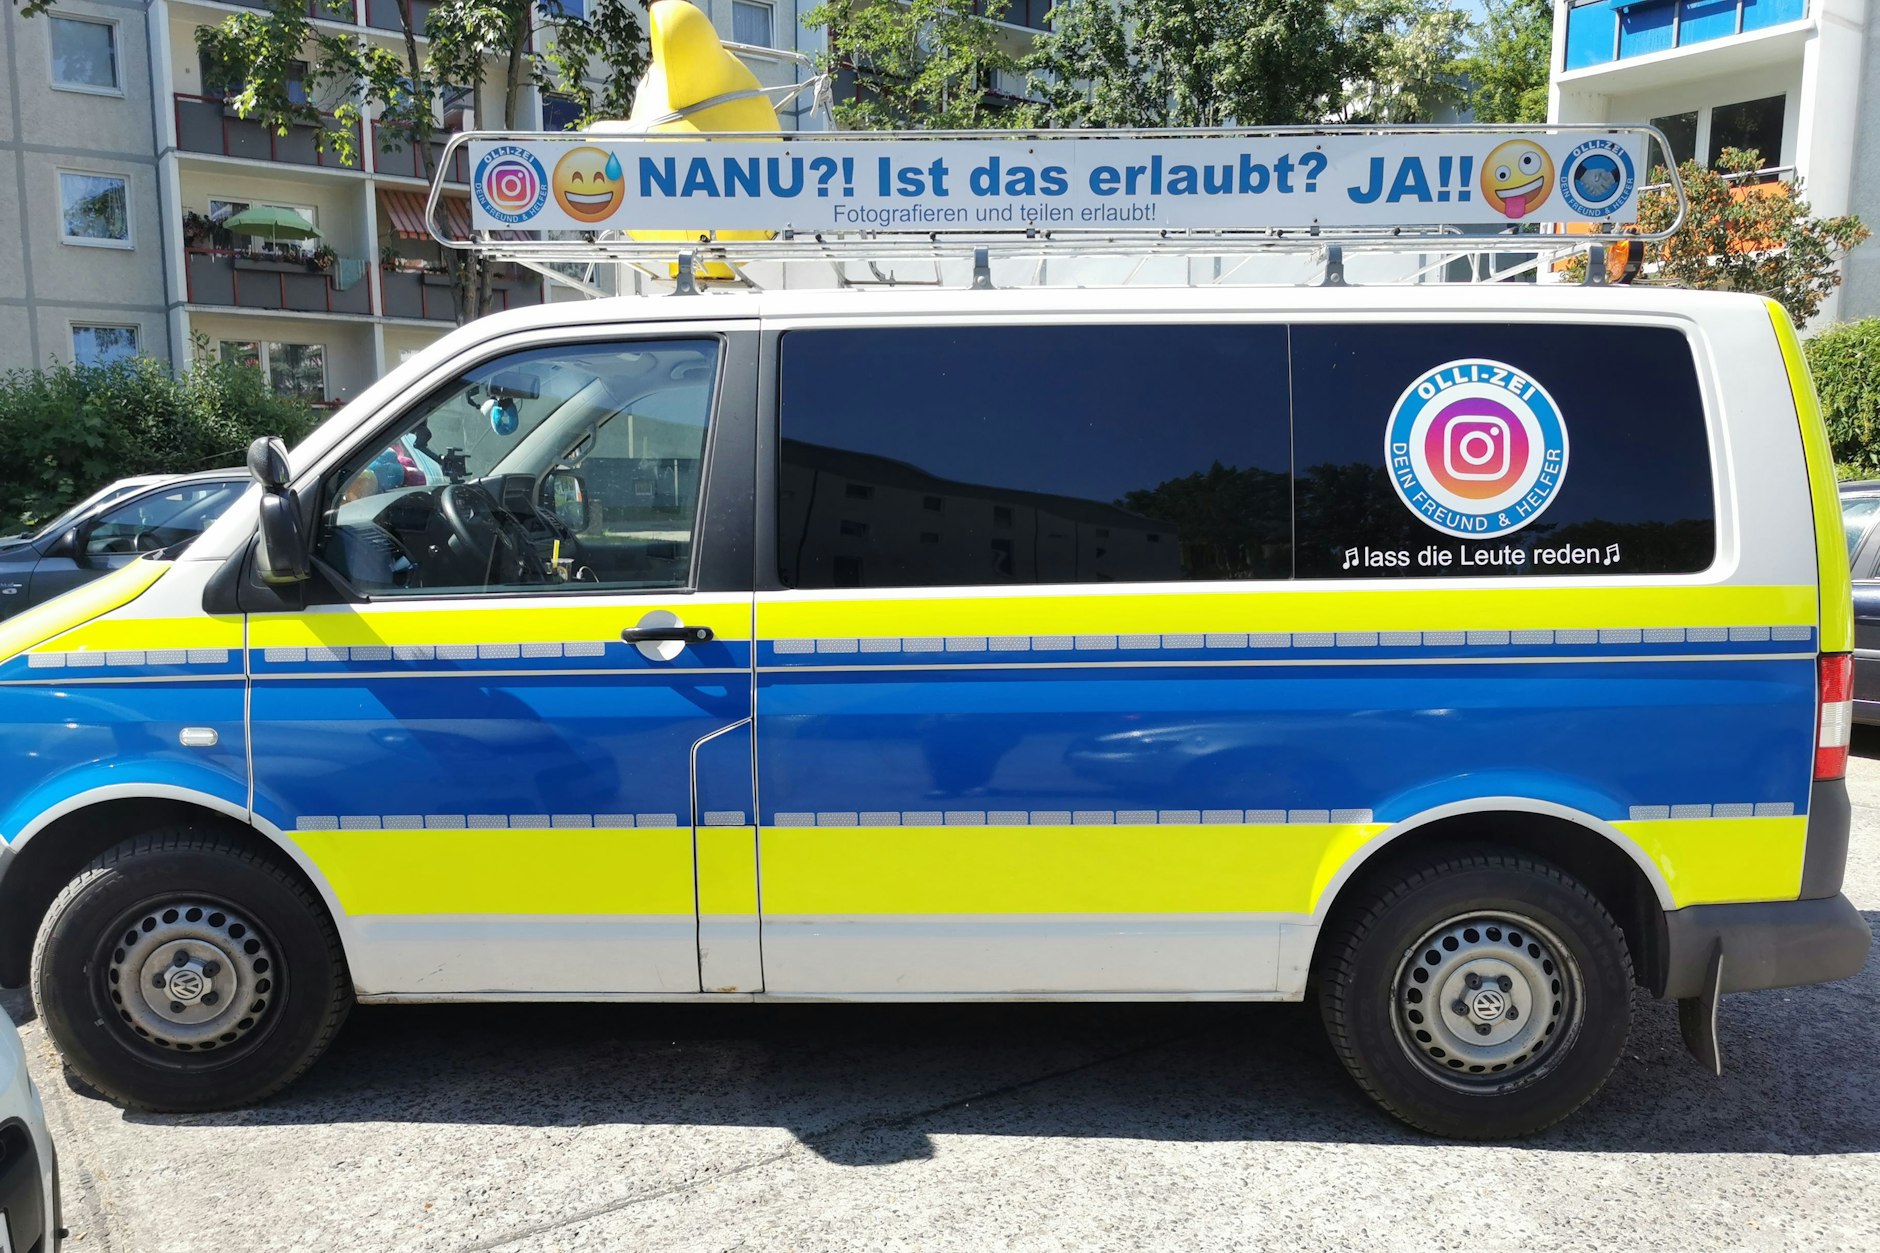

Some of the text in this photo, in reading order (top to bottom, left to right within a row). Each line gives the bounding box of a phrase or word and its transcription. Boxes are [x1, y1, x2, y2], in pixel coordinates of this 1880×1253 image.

[1573, 141, 1625, 157] OLLI-ZEI
[640, 152, 1473, 204] NANU?! Ist das erlaubt? JA!!
[1561, 176, 1571, 198] DEIN
[1568, 200, 1601, 216] FREUND
[1613, 177, 1634, 209] HELFER
[475, 183, 486, 204] DEIN
[485, 205, 519, 223] FREUND
[529, 184, 547, 216] HELFER
[834, 203, 1156, 227] Fotografieren und teilen erlaubt!
[1417, 365, 1537, 401] OLLI-ZEI
[1393, 442, 1560, 532] DEIN FREUND & HELFER
[1365, 544, 1599, 566] lass die Leute reden
